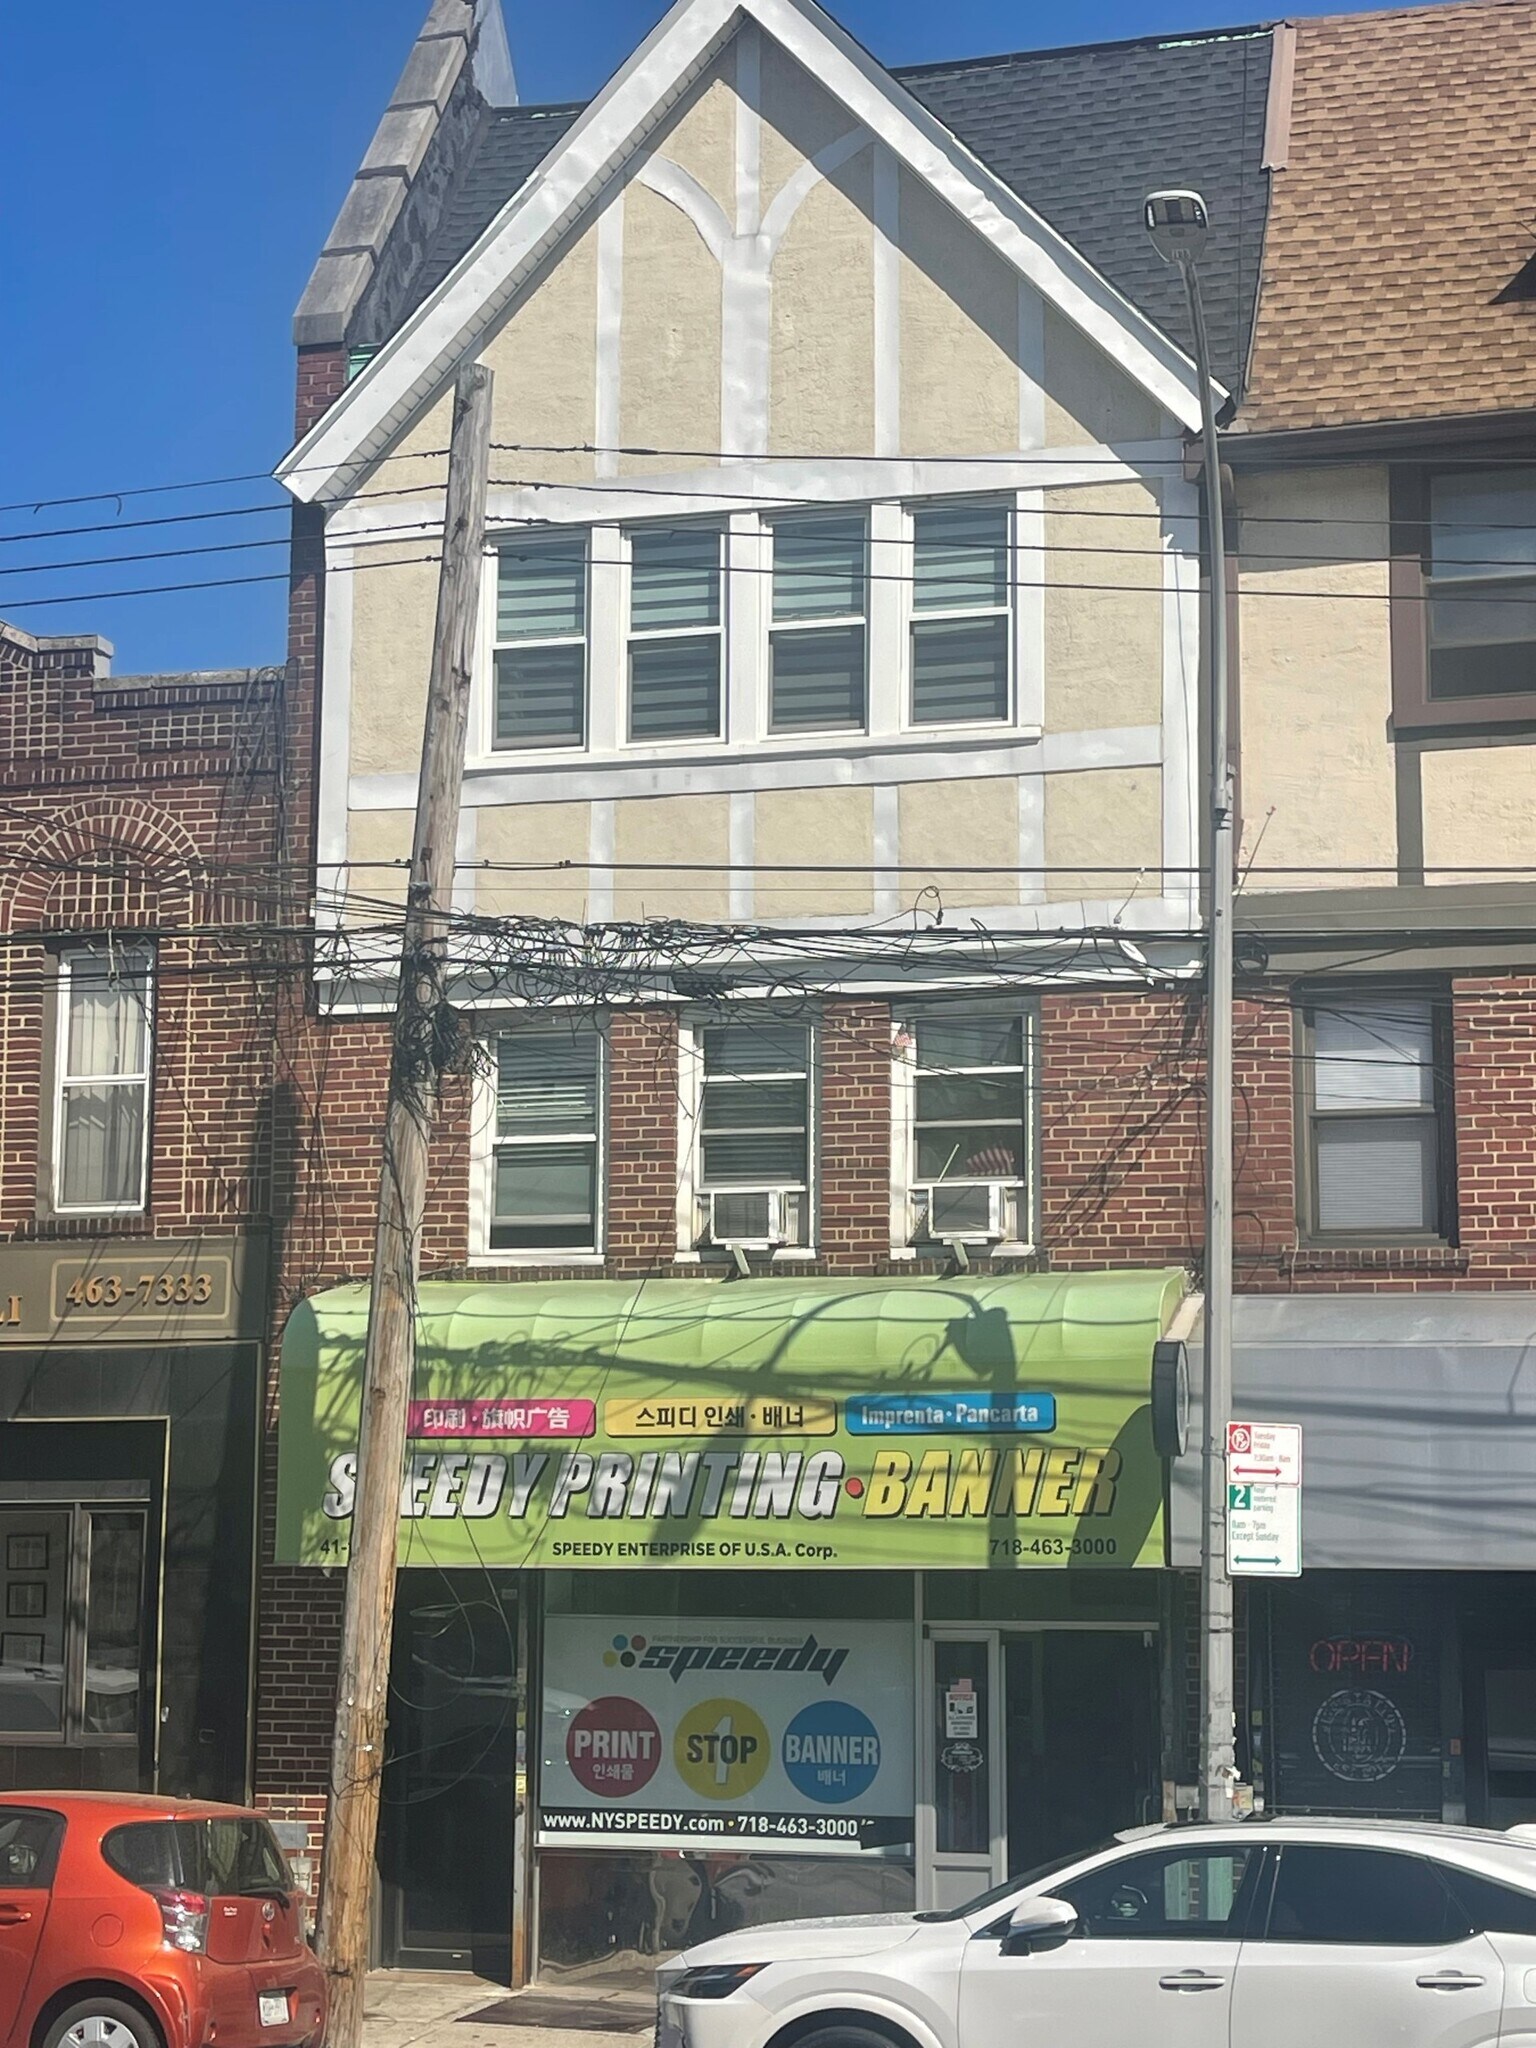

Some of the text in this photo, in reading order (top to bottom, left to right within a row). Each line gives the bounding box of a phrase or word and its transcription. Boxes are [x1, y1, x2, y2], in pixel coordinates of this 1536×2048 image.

[66, 1273, 212, 1307] 463-7333
[636, 1406, 804, 1428] 스피디 인쇄 배너
[322, 1448, 1123, 1520] SEEDY PRINTING BANNER
[1233, 1484, 1246, 1508] 2
[989, 1538, 1117, 1556] 718-463-3000
[1231, 1531, 1279, 1543] Except Sunday
[552, 1542, 837, 1560] SPEEDY ENTERPRISE OF U.S.A. Corp.
[638, 1633, 850, 1686] speedy
[574, 1729, 656, 1759] PRINT
[687, 1734, 758, 1765] STOP
[713, 1715, 732, 1784] 1
[785, 1734, 879, 1766] BANNER
[817, 1769, 846, 1787] 배너
[543, 1812, 858, 1837] www.NYSPEEDY.com 718-463-3000
